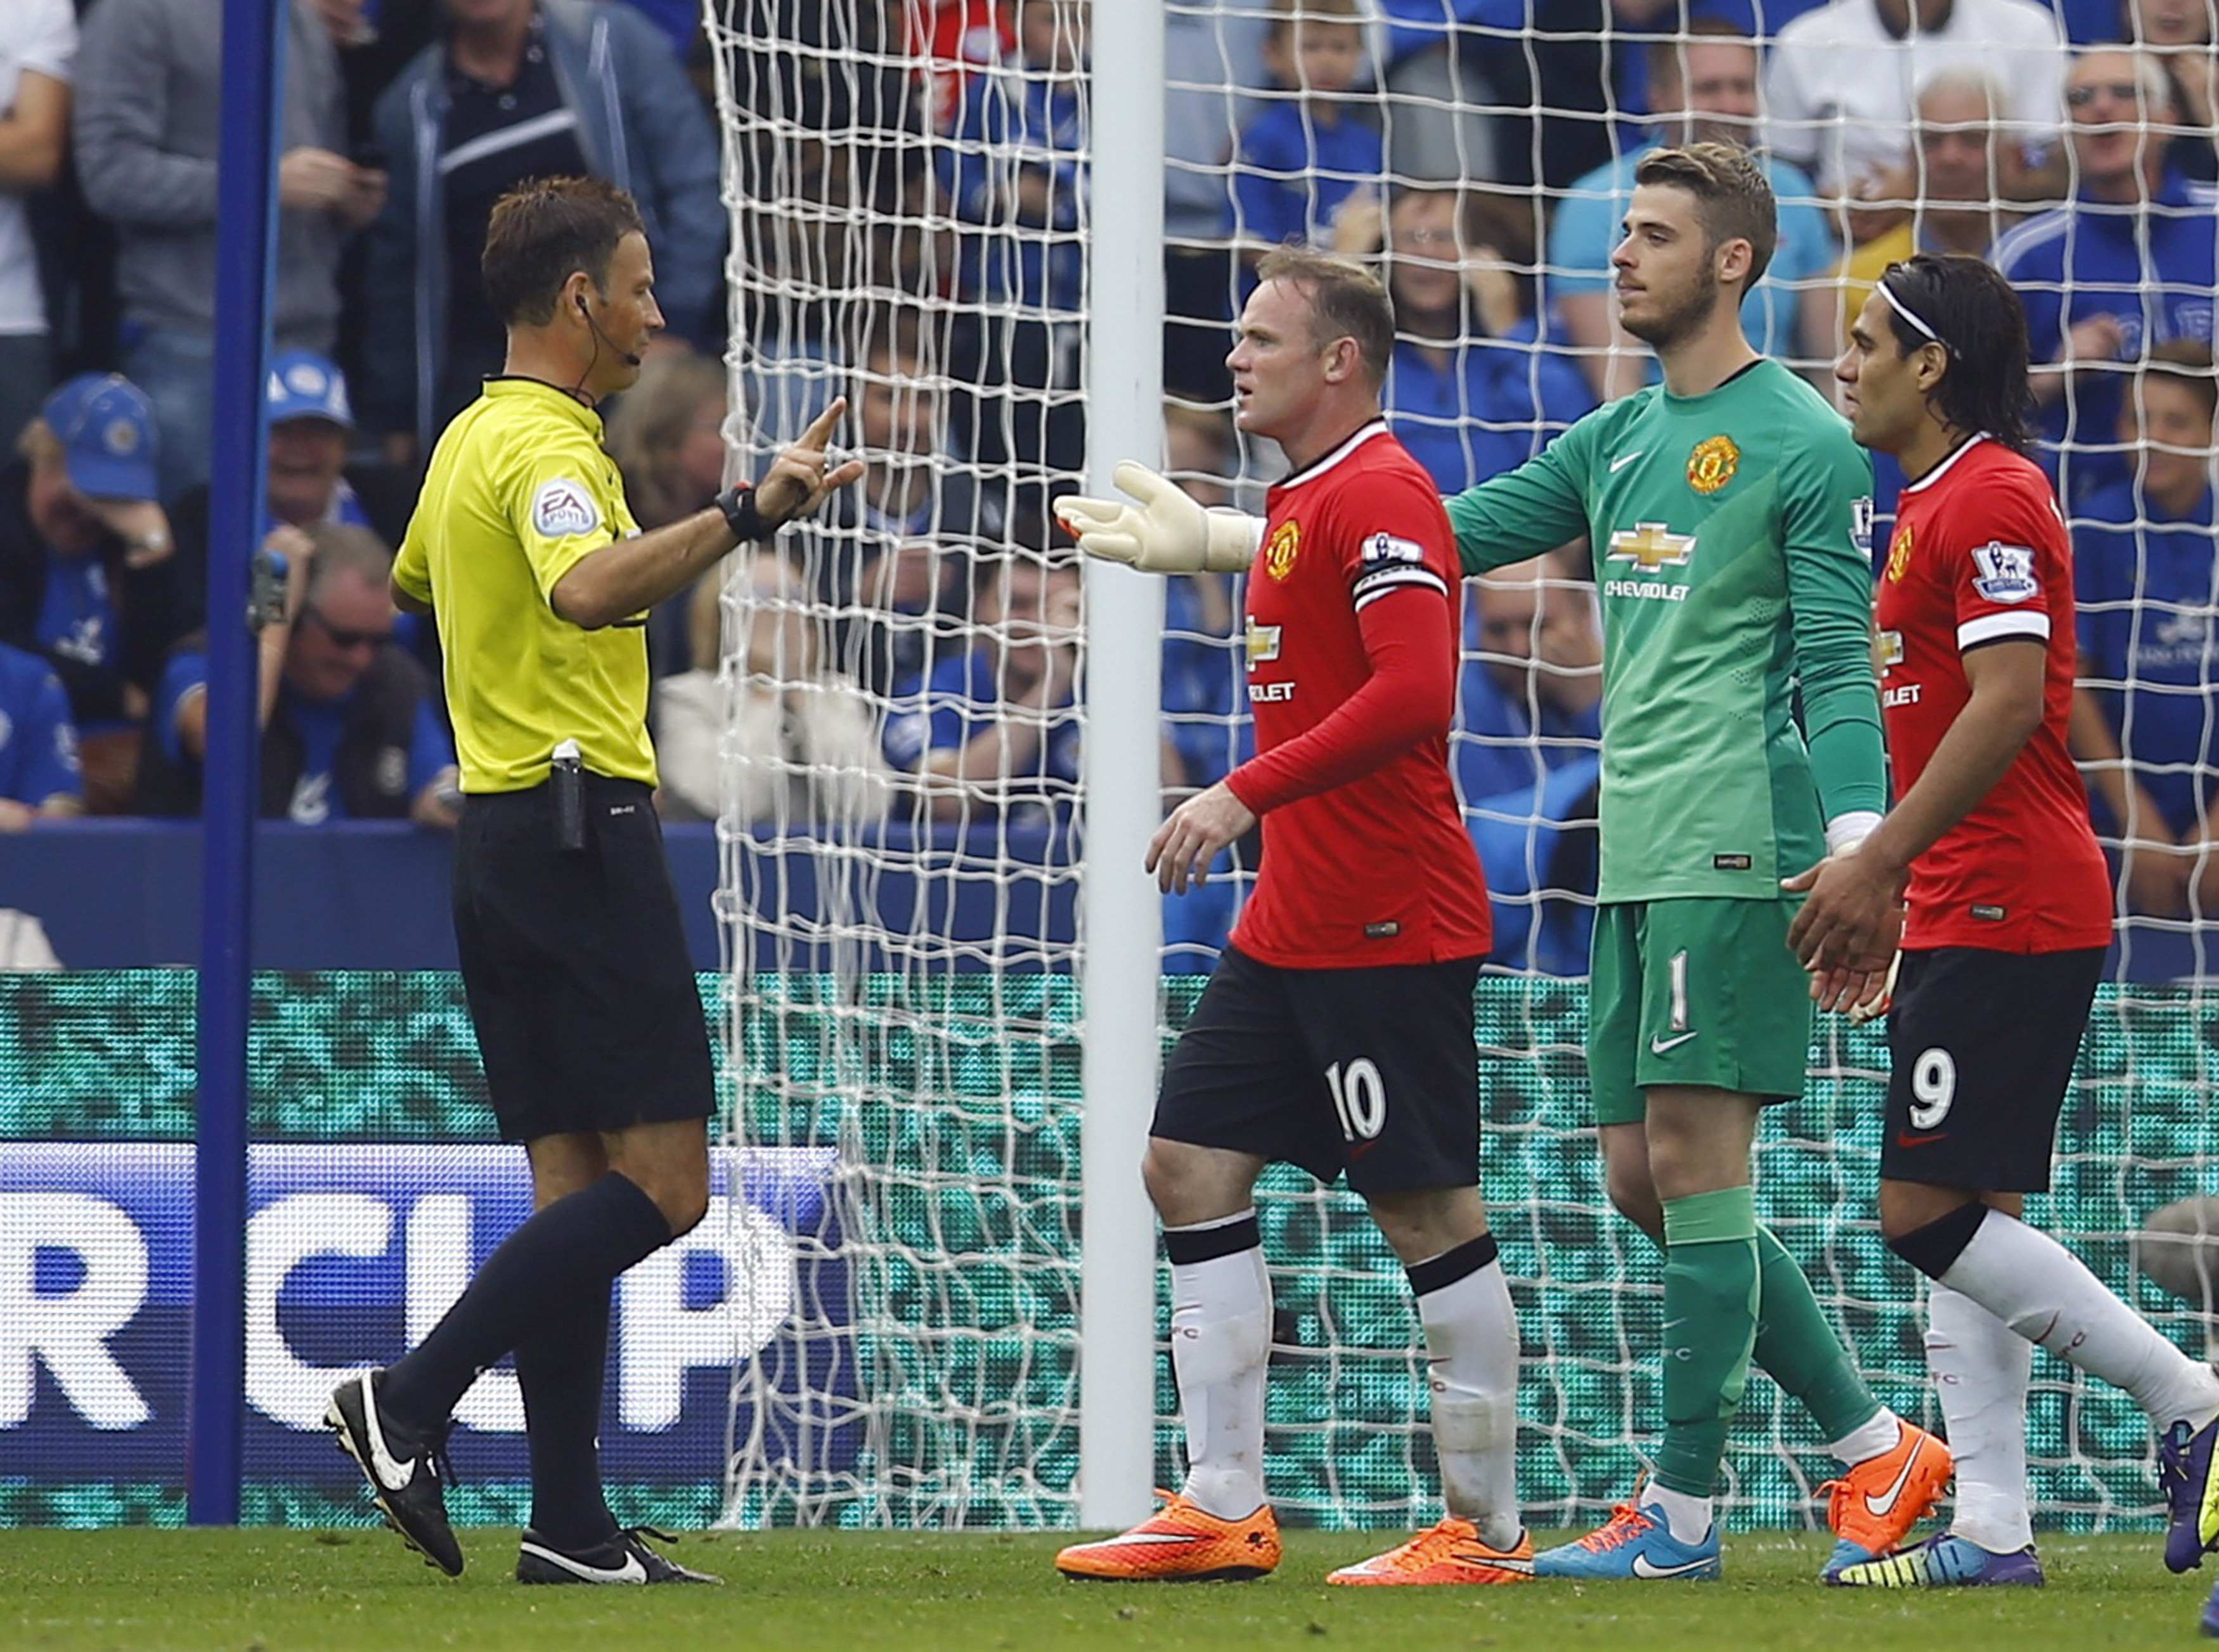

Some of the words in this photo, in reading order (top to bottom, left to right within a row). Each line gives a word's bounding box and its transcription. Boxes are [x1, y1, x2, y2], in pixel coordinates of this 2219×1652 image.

[541, 488, 585, 517] EA
[1604, 580, 1691, 601] CHEVROLET
[1668, 950, 1687, 1031] 1
[1324, 1057, 1387, 1141] 10
[1909, 1047, 1957, 1130] 9
